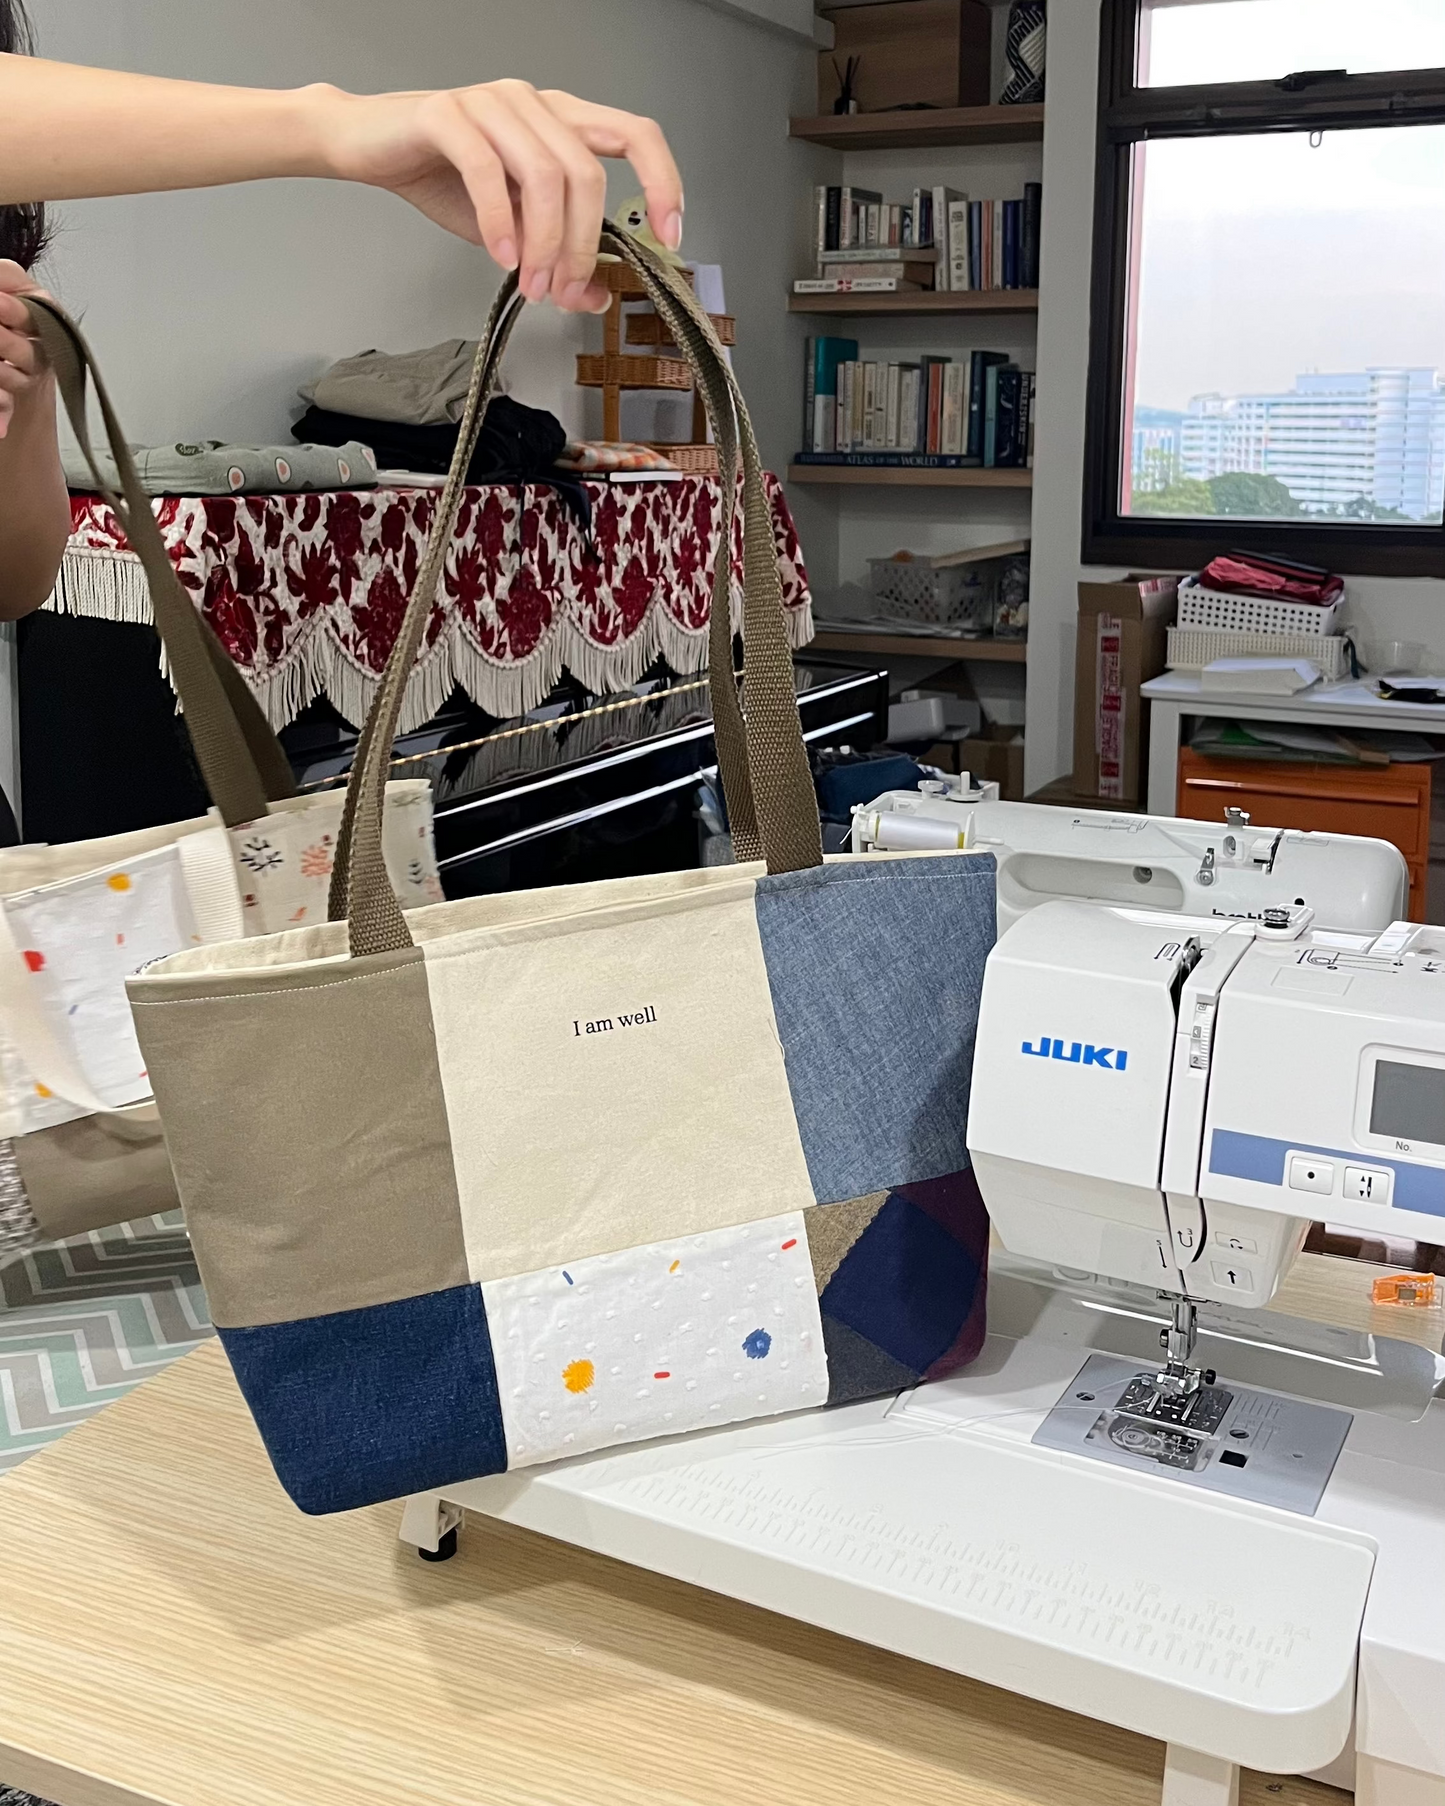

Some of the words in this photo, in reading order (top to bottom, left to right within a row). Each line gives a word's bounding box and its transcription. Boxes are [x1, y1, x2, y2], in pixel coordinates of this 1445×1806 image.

[846, 456, 873, 465] ATLAS
[901, 456, 938, 466] WORLD
[573, 1020, 581, 1037] I
[585, 1018, 614, 1034] am
[617, 1005, 657, 1028] well
[1021, 1036, 1128, 1071] JUKI
[1192, 1056, 1199, 1065] 2
[1395, 1140, 1412, 1152] No.
